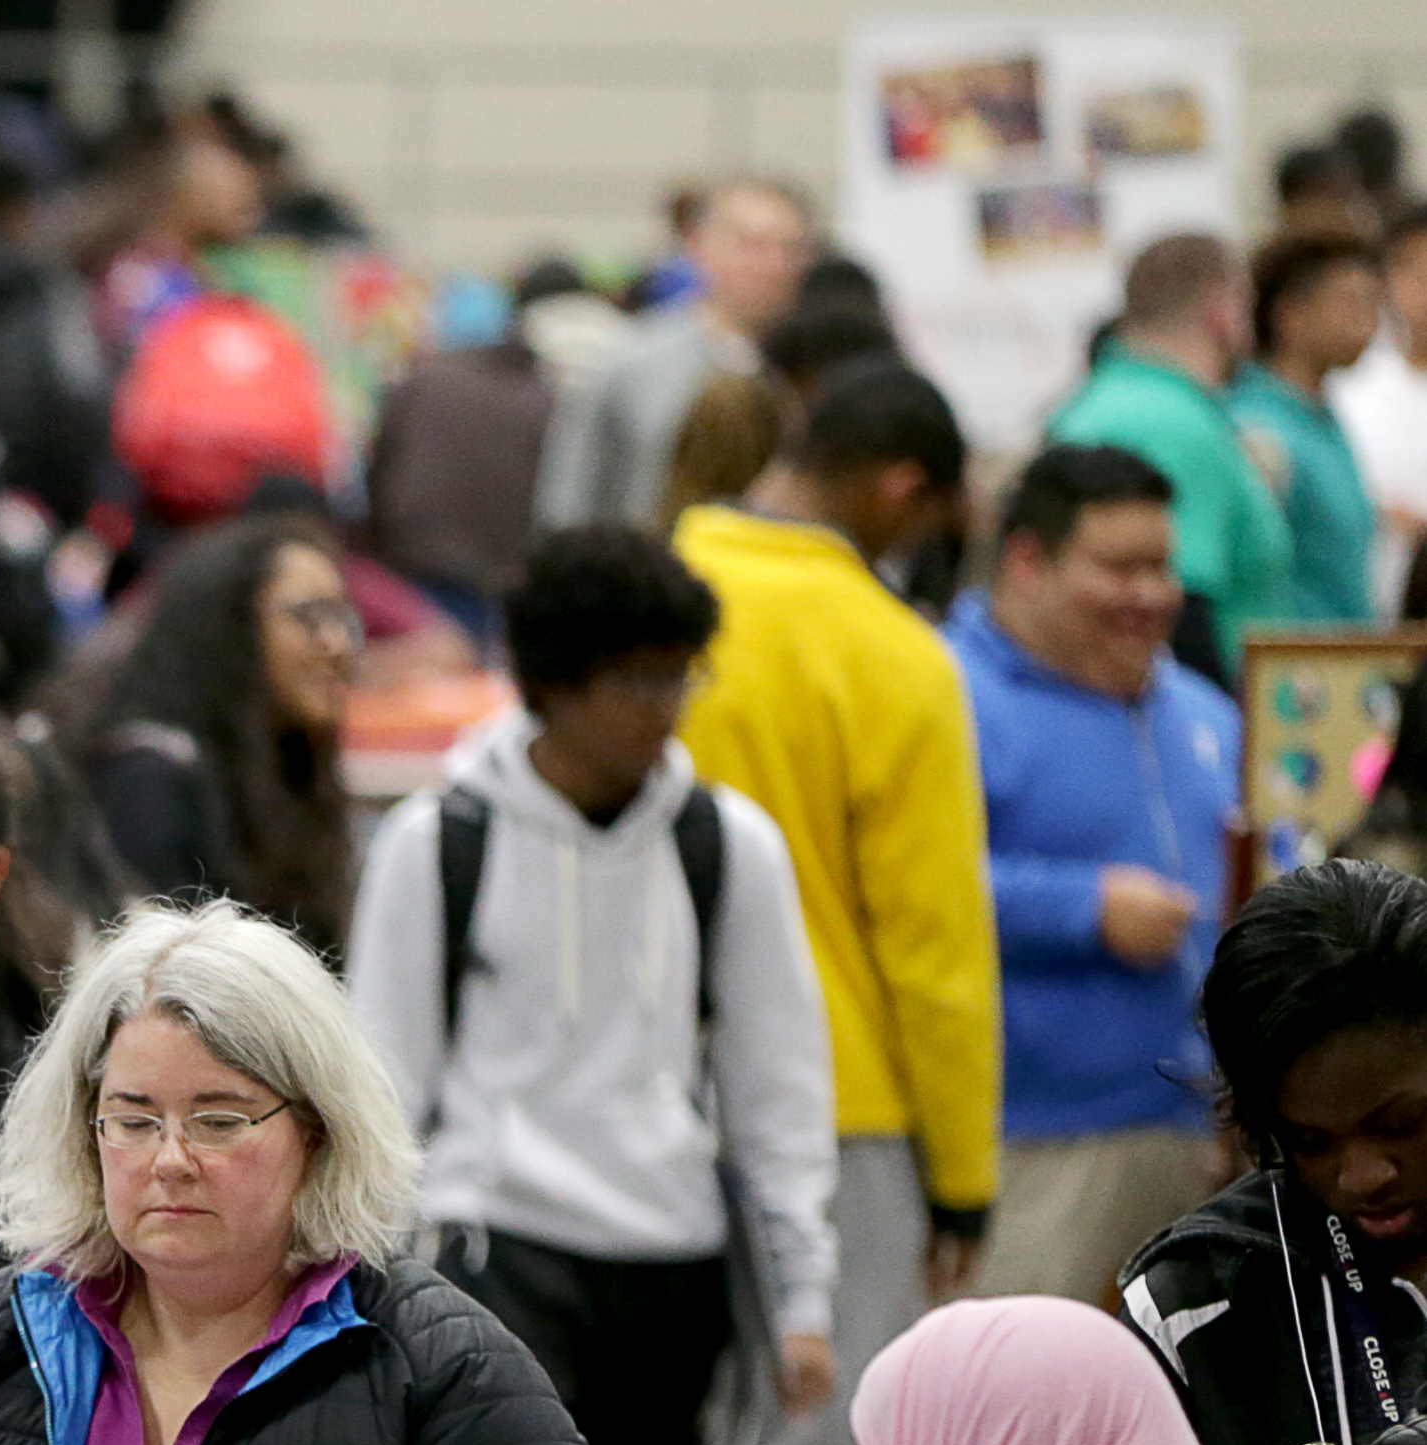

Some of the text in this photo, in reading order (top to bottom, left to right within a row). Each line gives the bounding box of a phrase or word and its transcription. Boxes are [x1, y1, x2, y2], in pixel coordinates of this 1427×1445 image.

[1326, 1214, 1364, 1294] CLOSE UP
[1363, 1336, 1400, 1424] CLOSE UP
